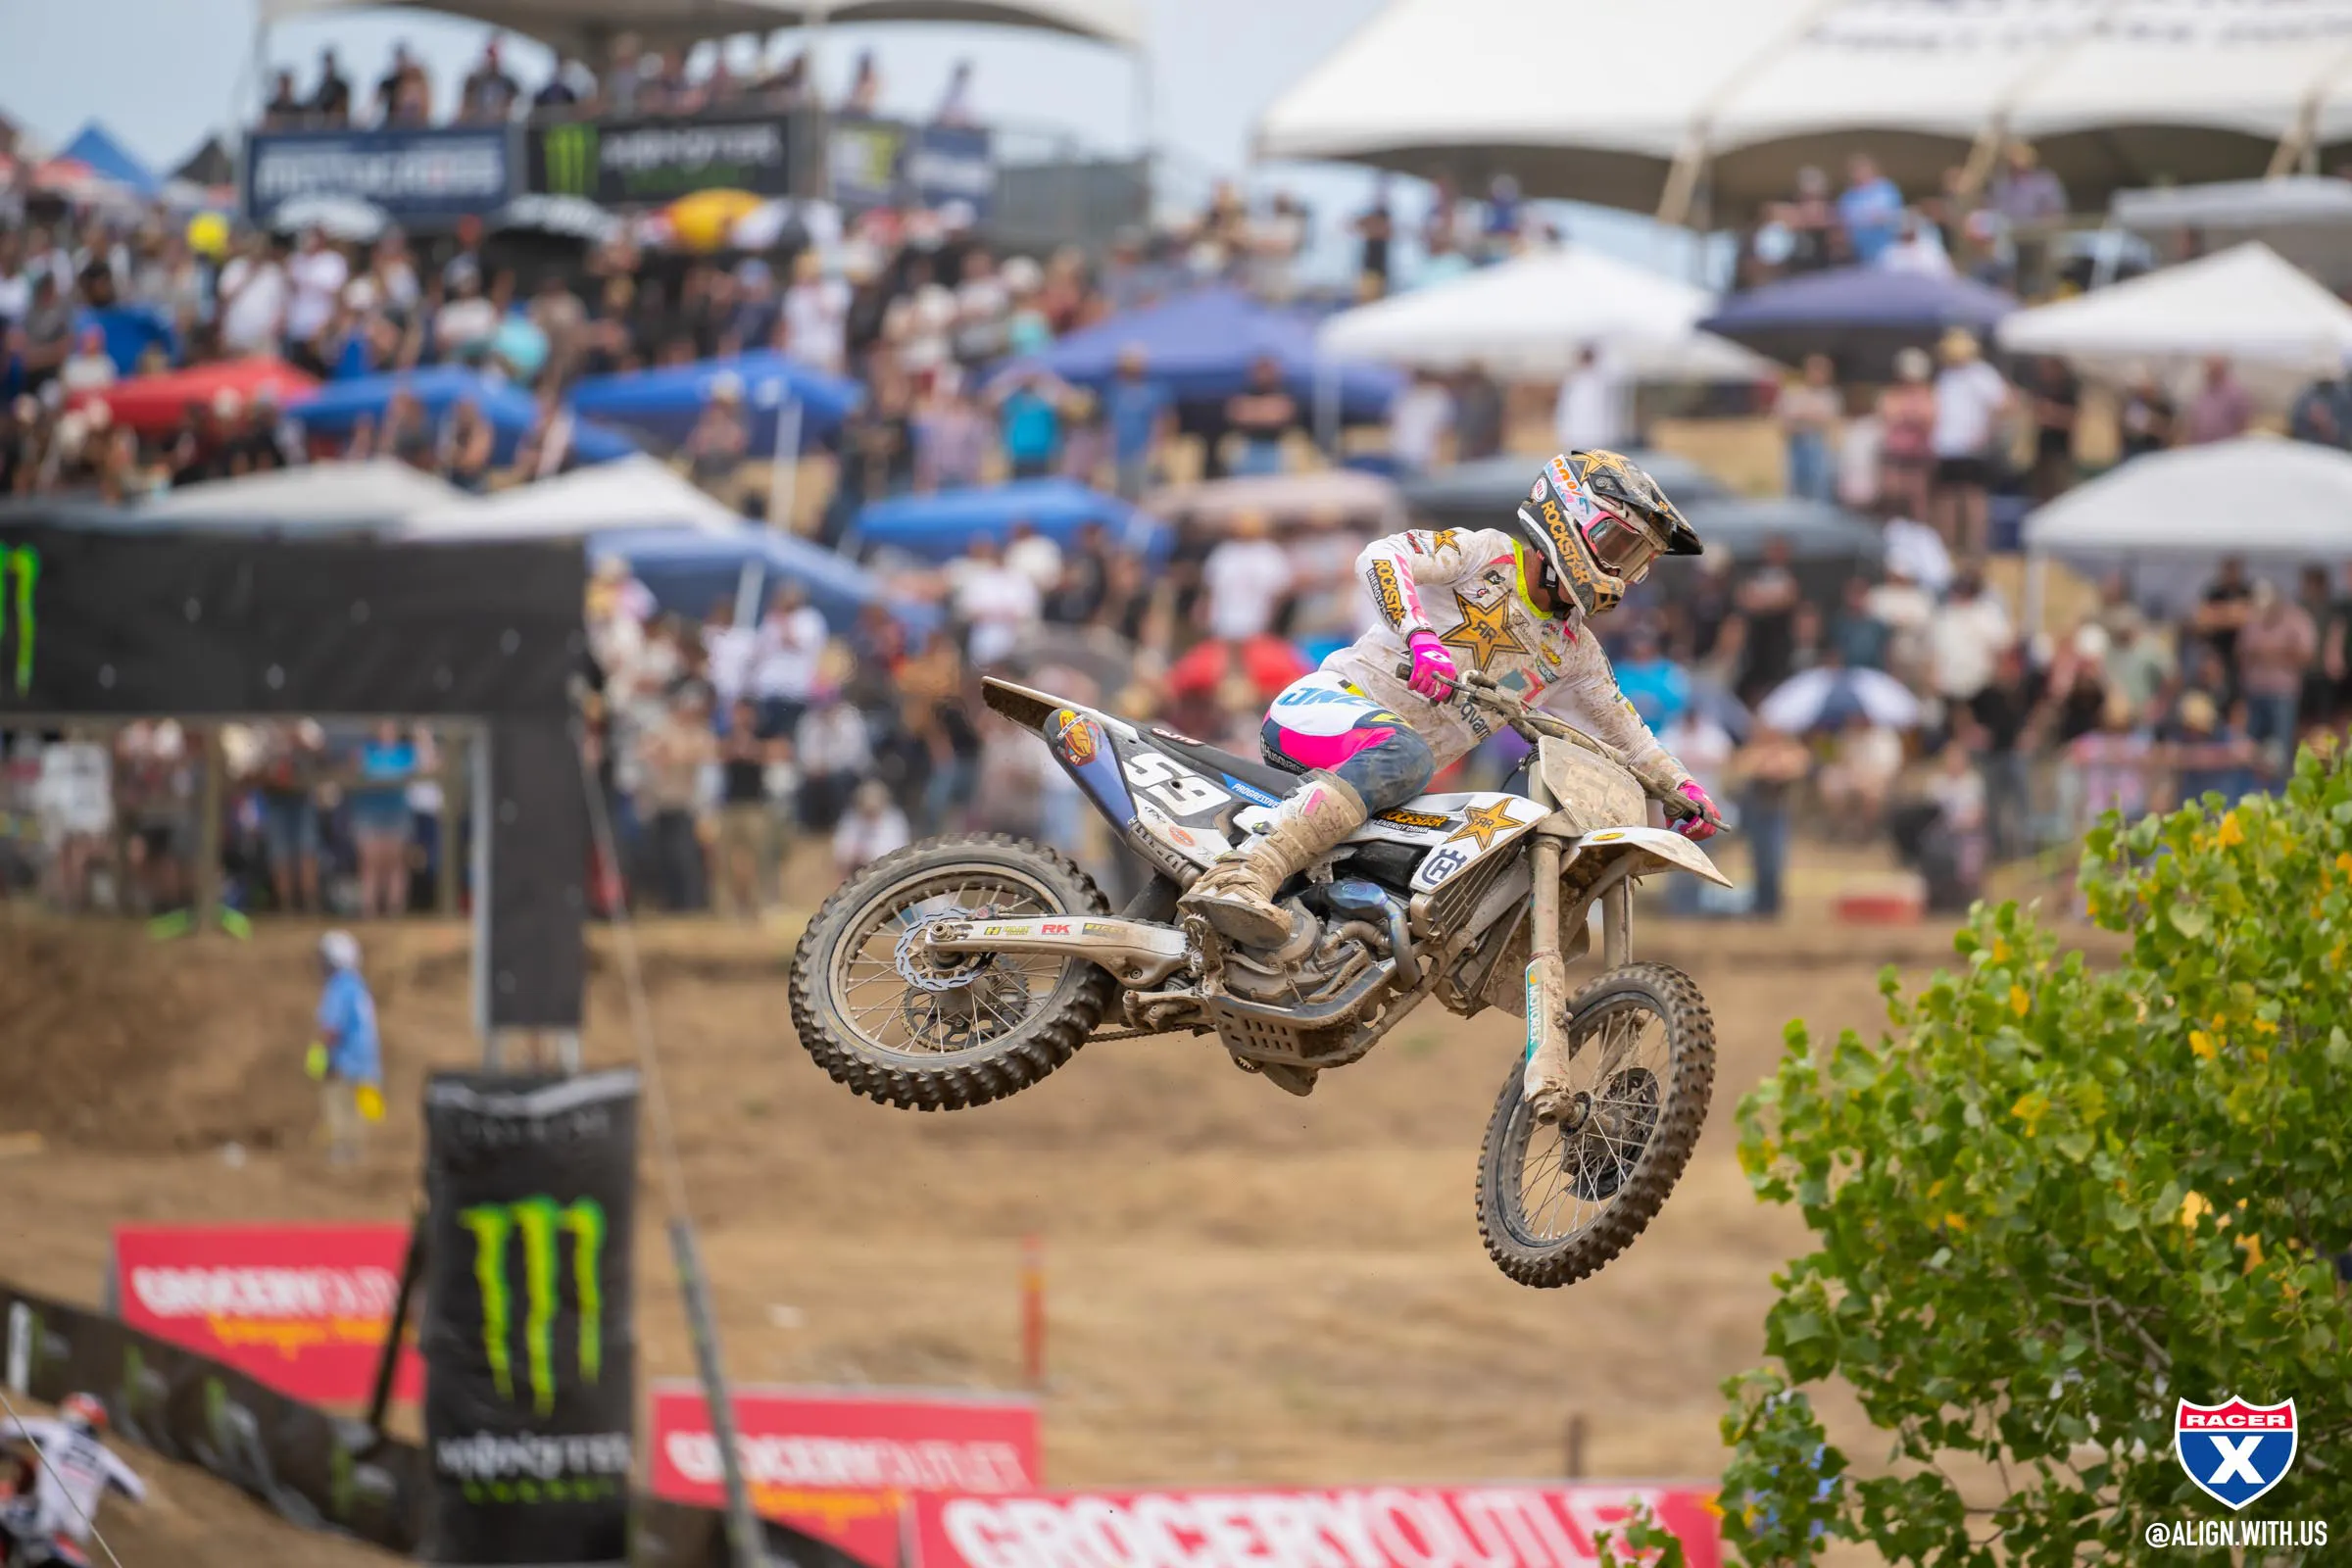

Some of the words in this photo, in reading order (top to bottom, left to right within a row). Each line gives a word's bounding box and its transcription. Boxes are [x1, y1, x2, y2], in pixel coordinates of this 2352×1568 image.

[1541, 500, 1592, 585] ROCKSTAR
[1122, 753, 1231, 817] 59
[1231, 783, 1281, 809] PROGRESSIVE
[1376, 819, 1405, 831] ENERGY
[1405, 825, 1431, 834] DRINK
[1041, 924, 1071, 935] RK
[1529, 984, 1543, 1044] MOTOREX
